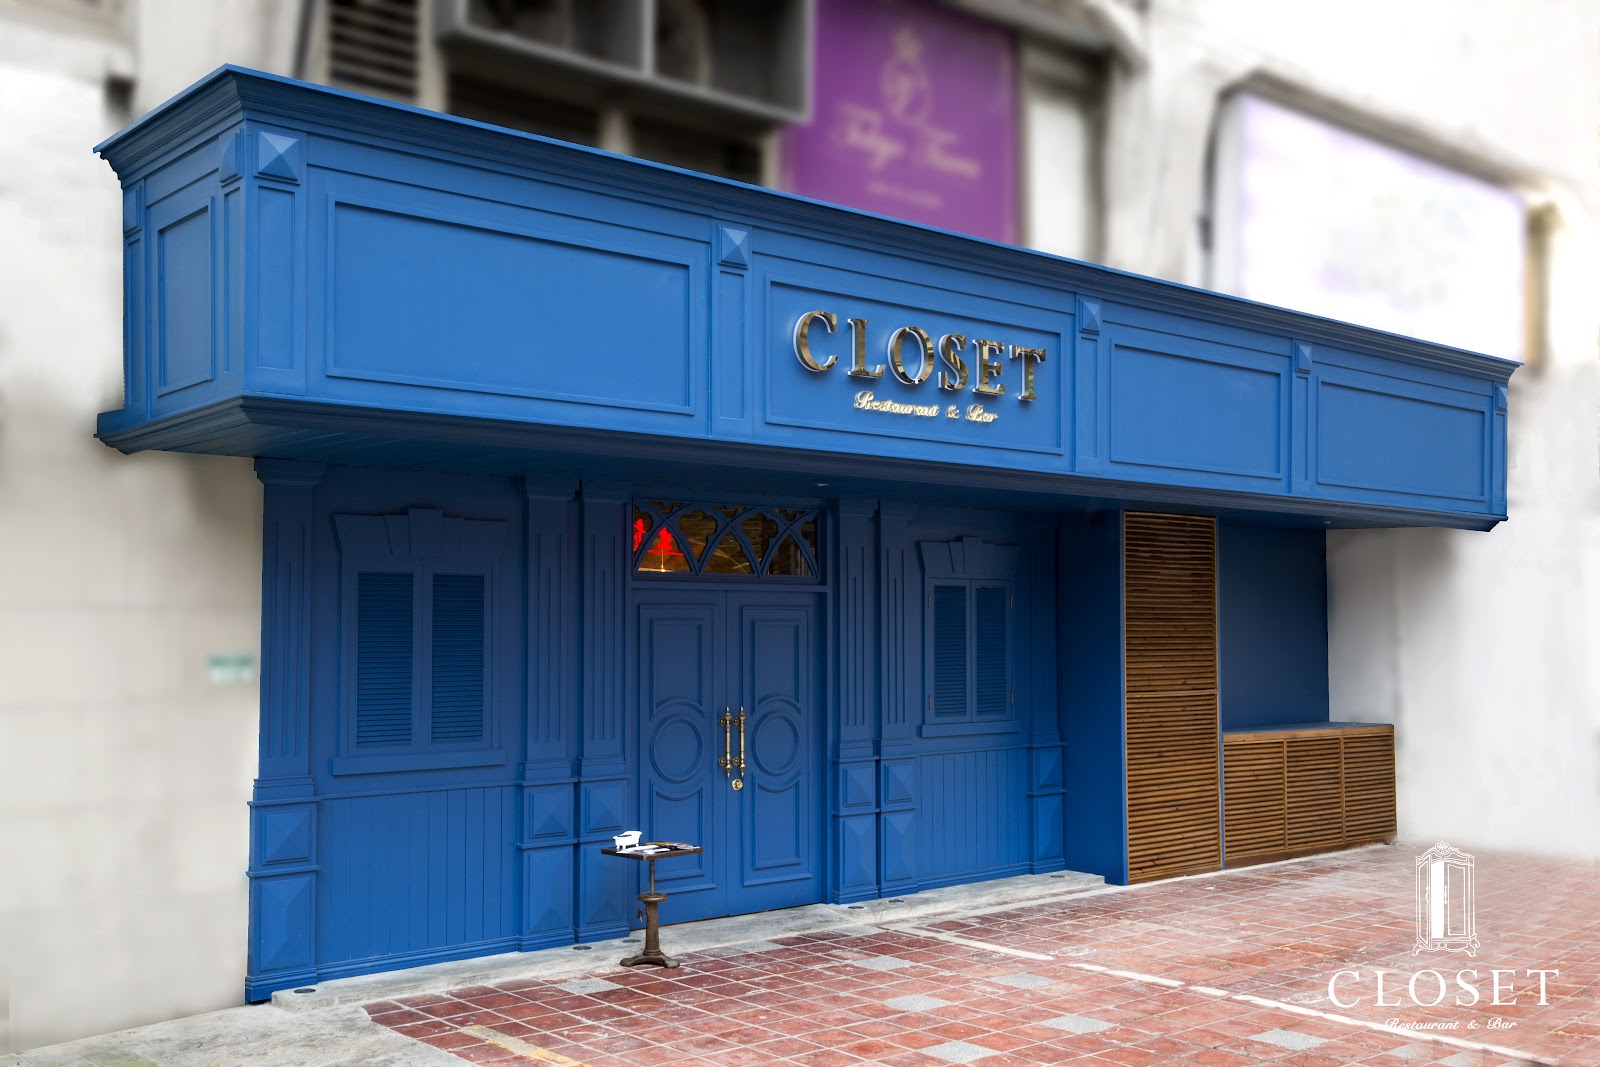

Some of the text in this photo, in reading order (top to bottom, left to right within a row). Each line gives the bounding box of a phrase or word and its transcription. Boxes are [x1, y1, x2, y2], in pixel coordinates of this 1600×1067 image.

[793, 310, 1046, 401] CLOSET
[854, 390, 999, 423] Restaurant & Bar
